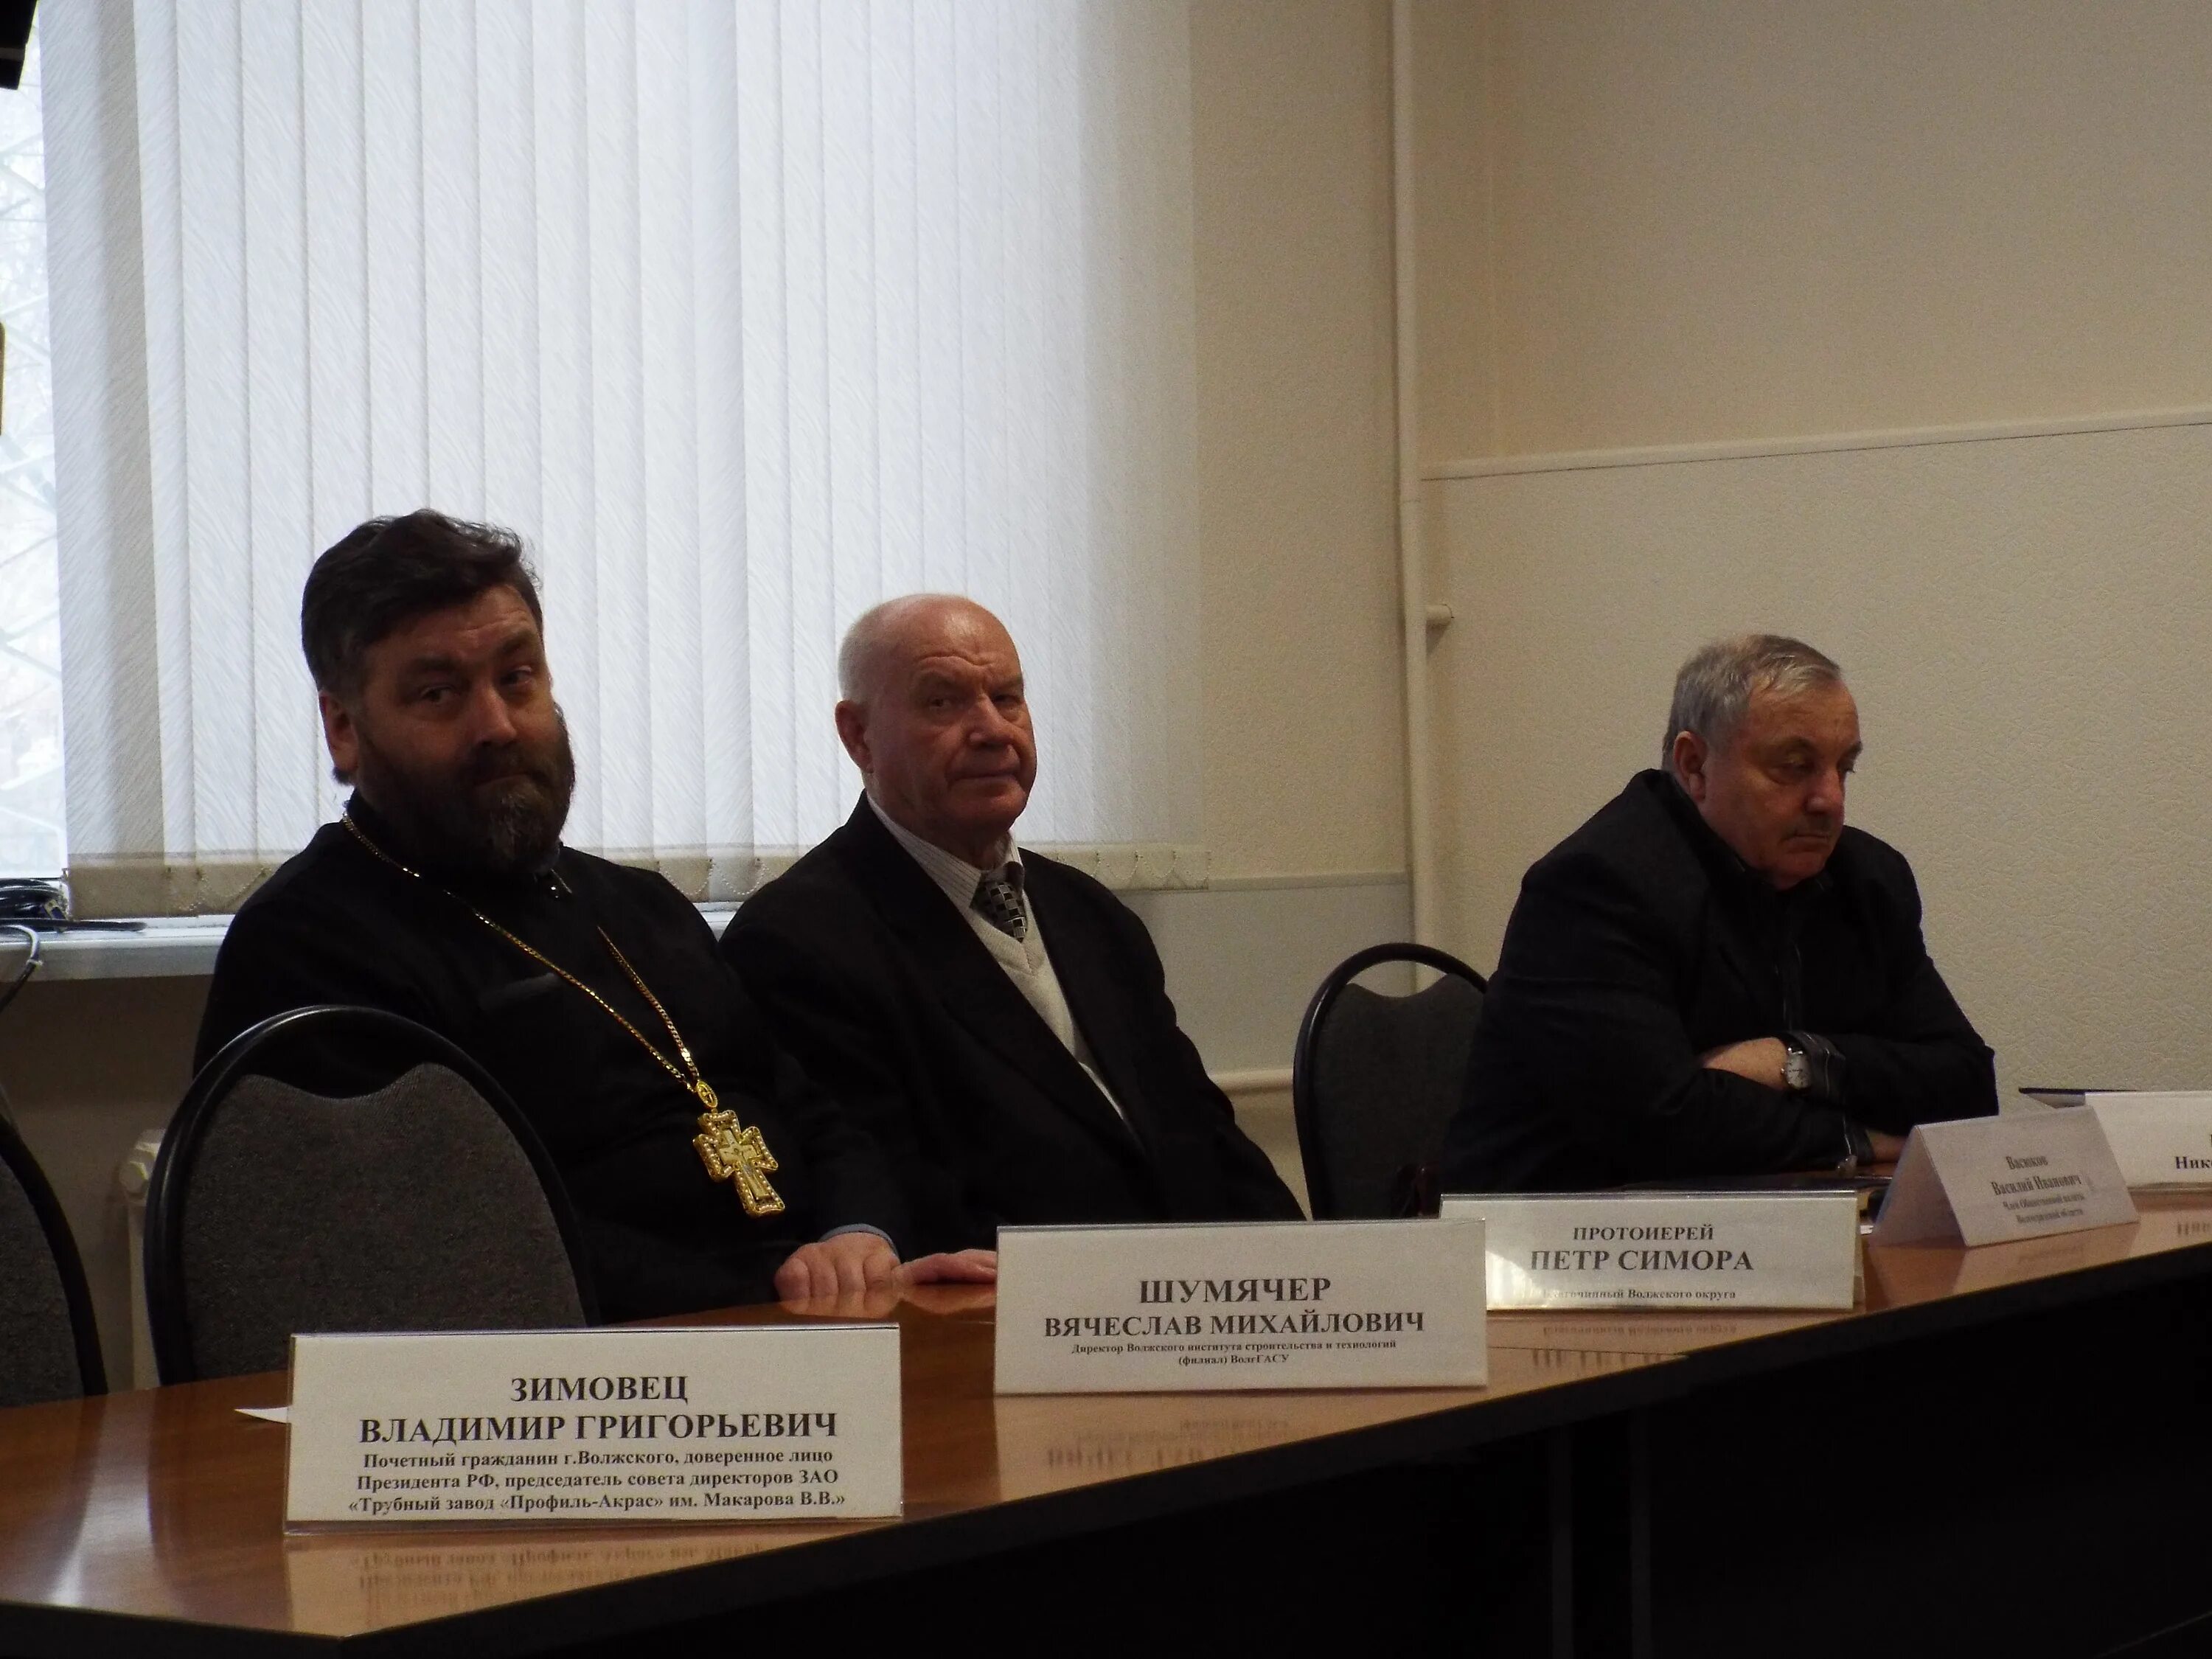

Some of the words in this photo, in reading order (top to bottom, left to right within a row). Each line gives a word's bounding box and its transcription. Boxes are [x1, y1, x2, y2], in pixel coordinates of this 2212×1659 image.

[1991, 1178, 2034, 1195] Василий
[2033, 1175, 2081, 1189] Иванович
[1573, 1224, 1714, 1240] ПРОТОИЕРЕЙ
[1531, 1251, 1610, 1270] ПЕТР
[1618, 1250, 1754, 1270] СИМОРА
[1140, 1278, 1331, 1303] ШУМЯЧЕР
[1627, 1290, 1692, 1300] Волжского
[1695, 1291, 1736, 1301] округа
[1044, 1315, 1202, 1337] ВЯЧЕСЛАВ
[1210, 1309, 1425, 1335] МИХАЙЛОВИЧ
[1071, 1343, 1123, 1354] Директор
[1127, 1343, 1184, 1353] Волжского
[1188, 1343, 1242, 1352] института
[1245, 1340, 1323, 1352] строительства
[1335, 1340, 1397, 1350] технологий
[1178, 1354, 1228, 1366] (филиал)
[1231, 1354, 1290, 1363] ВолгГАСУ
[511, 1376, 689, 1404] ЗИМОВЕЦ
[359, 1416, 565, 1447] ВЛАДИМИР
[575, 1413, 838, 1439] ГРИГОРЬЕВИЧ
[364, 1453, 455, 1468] Почетный
[461, 1454, 557, 1471] гражданин
[563, 1450, 679, 1466] г.Волжского,
[684, 1452, 784, 1468] доверенное
[788, 1451, 833, 1464] лицо
[357, 1475, 460, 1492] Президента
[466, 1473, 499, 1490] РФ,
[505, 1475, 622, 1492] председатель
[627, 1473, 684, 1486] совета
[689, 1472, 793, 1489] директоров
[799, 1469, 838, 1484] ЗАО
[349, 1497, 440, 1515] «Трубный
[445, 1499, 494, 1510] завод
[501, 1494, 663, 1512] «Профиль-Акрас»
[669, 1496, 698, 1507] им.
[704, 1492, 793, 1509] Макарова
[800, 1491, 845, 1505] В.В.»
